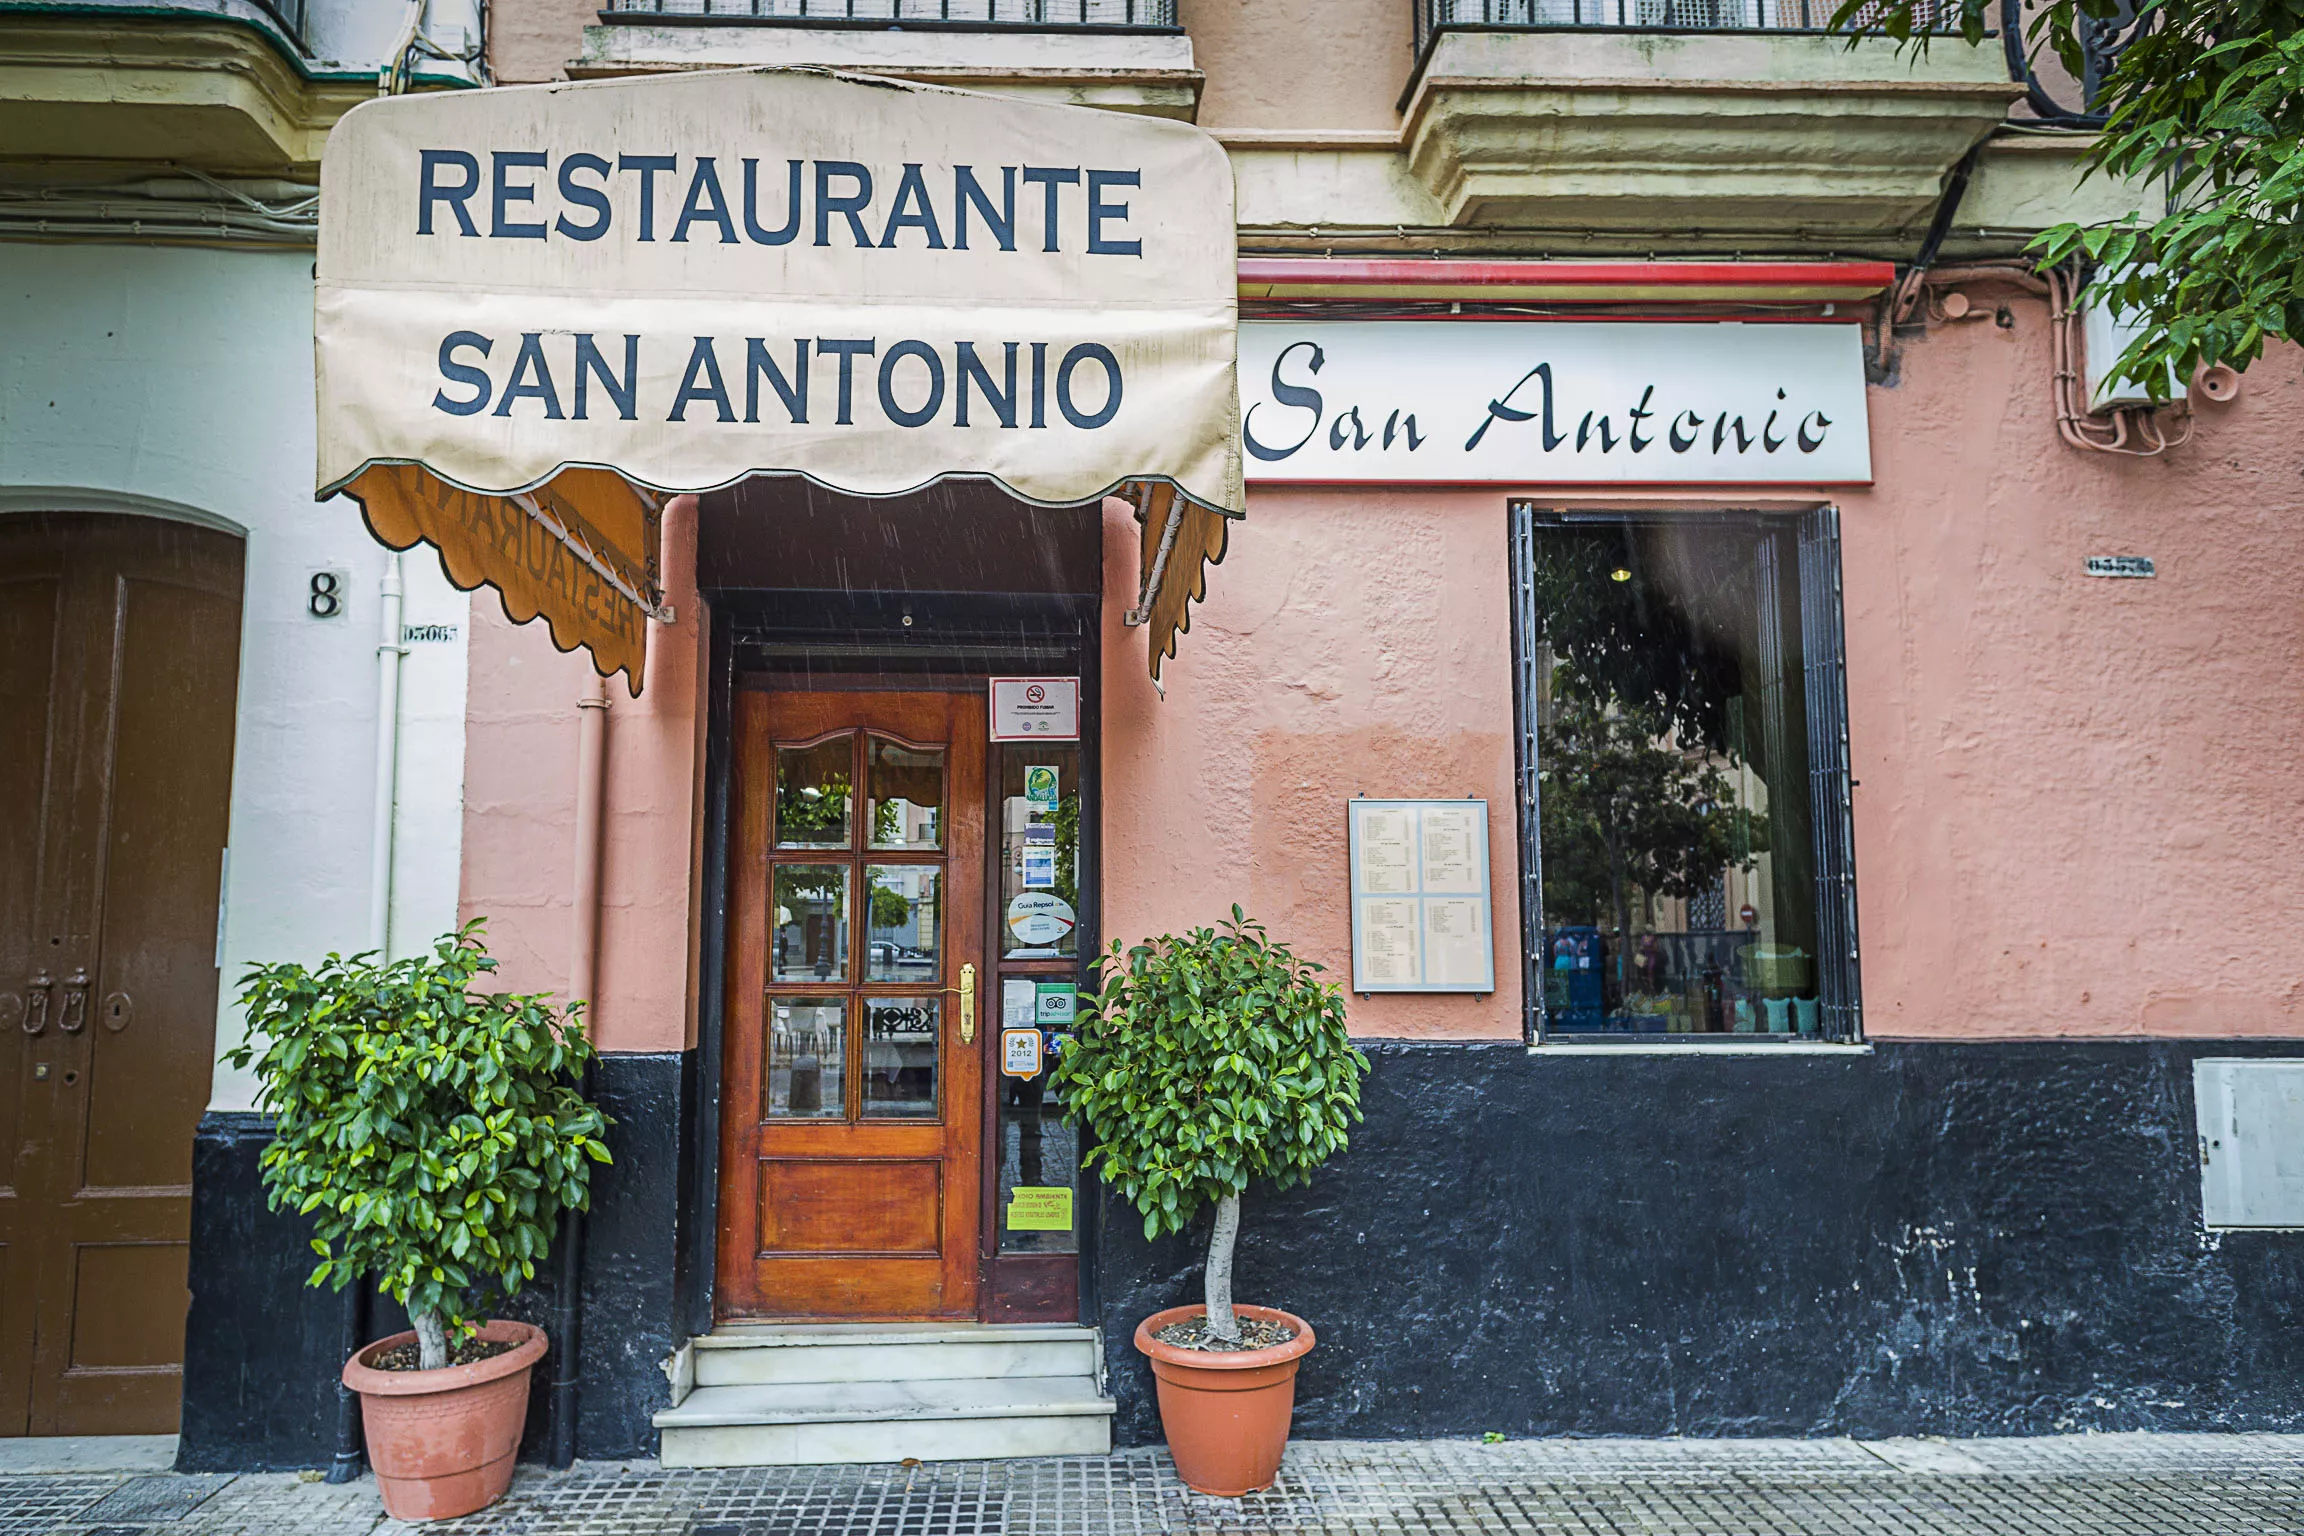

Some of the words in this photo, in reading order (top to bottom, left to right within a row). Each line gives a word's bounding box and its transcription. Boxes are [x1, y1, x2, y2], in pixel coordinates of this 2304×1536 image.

[418, 149, 1143, 259] RESTAURANTE
[433, 330, 641, 422] SAN
[666, 336, 1125, 430] ANTONIO
[1243, 341, 1427, 461] San
[1464, 361, 1833, 455] Antonio
[309, 572, 342, 618] 8
[1033, 900, 1054, 909] Repsol
